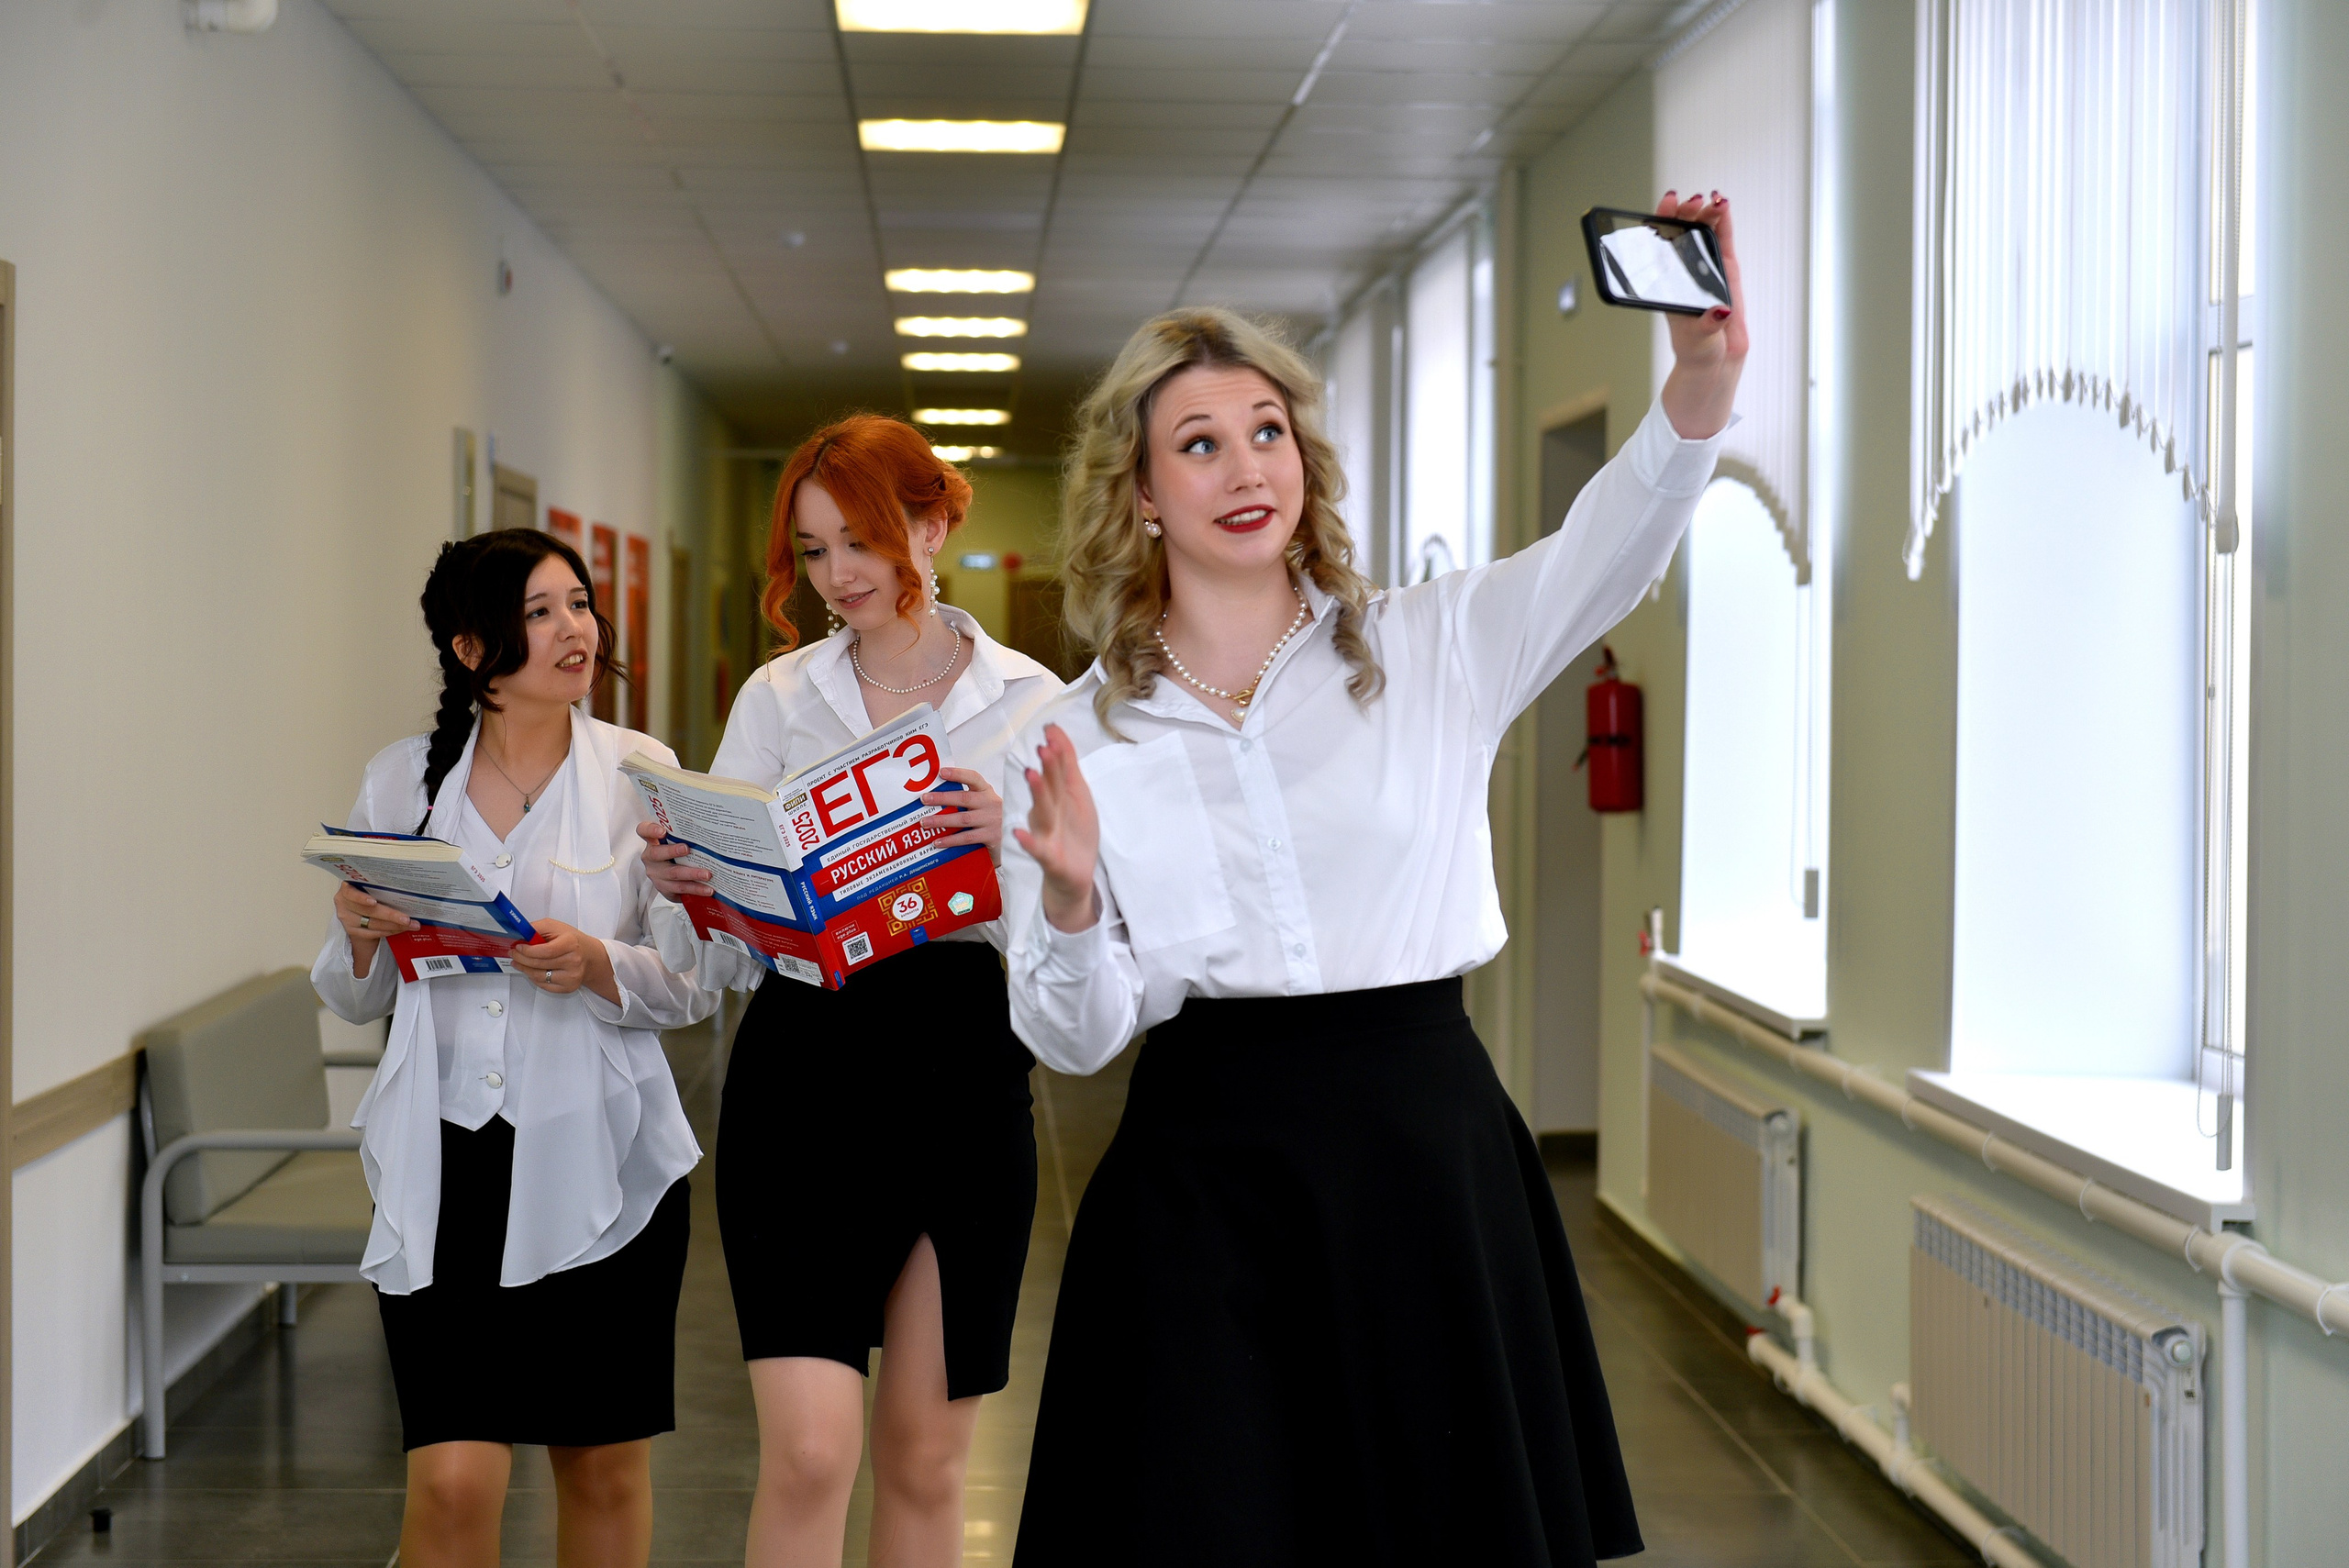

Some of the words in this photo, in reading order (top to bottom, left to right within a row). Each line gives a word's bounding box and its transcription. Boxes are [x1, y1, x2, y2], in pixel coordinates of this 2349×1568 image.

[807, 773, 826, 787] ПРОЕКТ
[833, 756, 861, 774] УЧАСТИЕМ
[862, 735, 904, 759] РАЗРАБОТЧИКОВ
[906, 728, 918, 738] КИМ
[918, 722, 929, 731] ЕГЭ
[809, 734, 941, 839] ЕГЭ
[648, 795, 673, 832] 2025
[792, 811, 820, 851] 2025
[827, 847, 852, 862] ЕДИНЫЙ
[852, 820, 908, 850] ГОСУДАРСТВЕННЫЙ
[909, 806, 936, 822] ЭКЗАМЕН
[830, 838, 898, 884] РУССКИЙ
[839, 880, 864, 895] ТИПОВЫЕ
[866, 854, 918, 883] ЭКЗАМЕНАЦИОННЫЕ
[800, 882, 813, 906] РУССКИЙ
[809, 905, 818, 921] ЯЗЫК
[856, 893, 868, 901] ПОД
[868, 877, 899, 895] РЕДАКЦИЕЙ
[897, 896, 918, 913] 36
